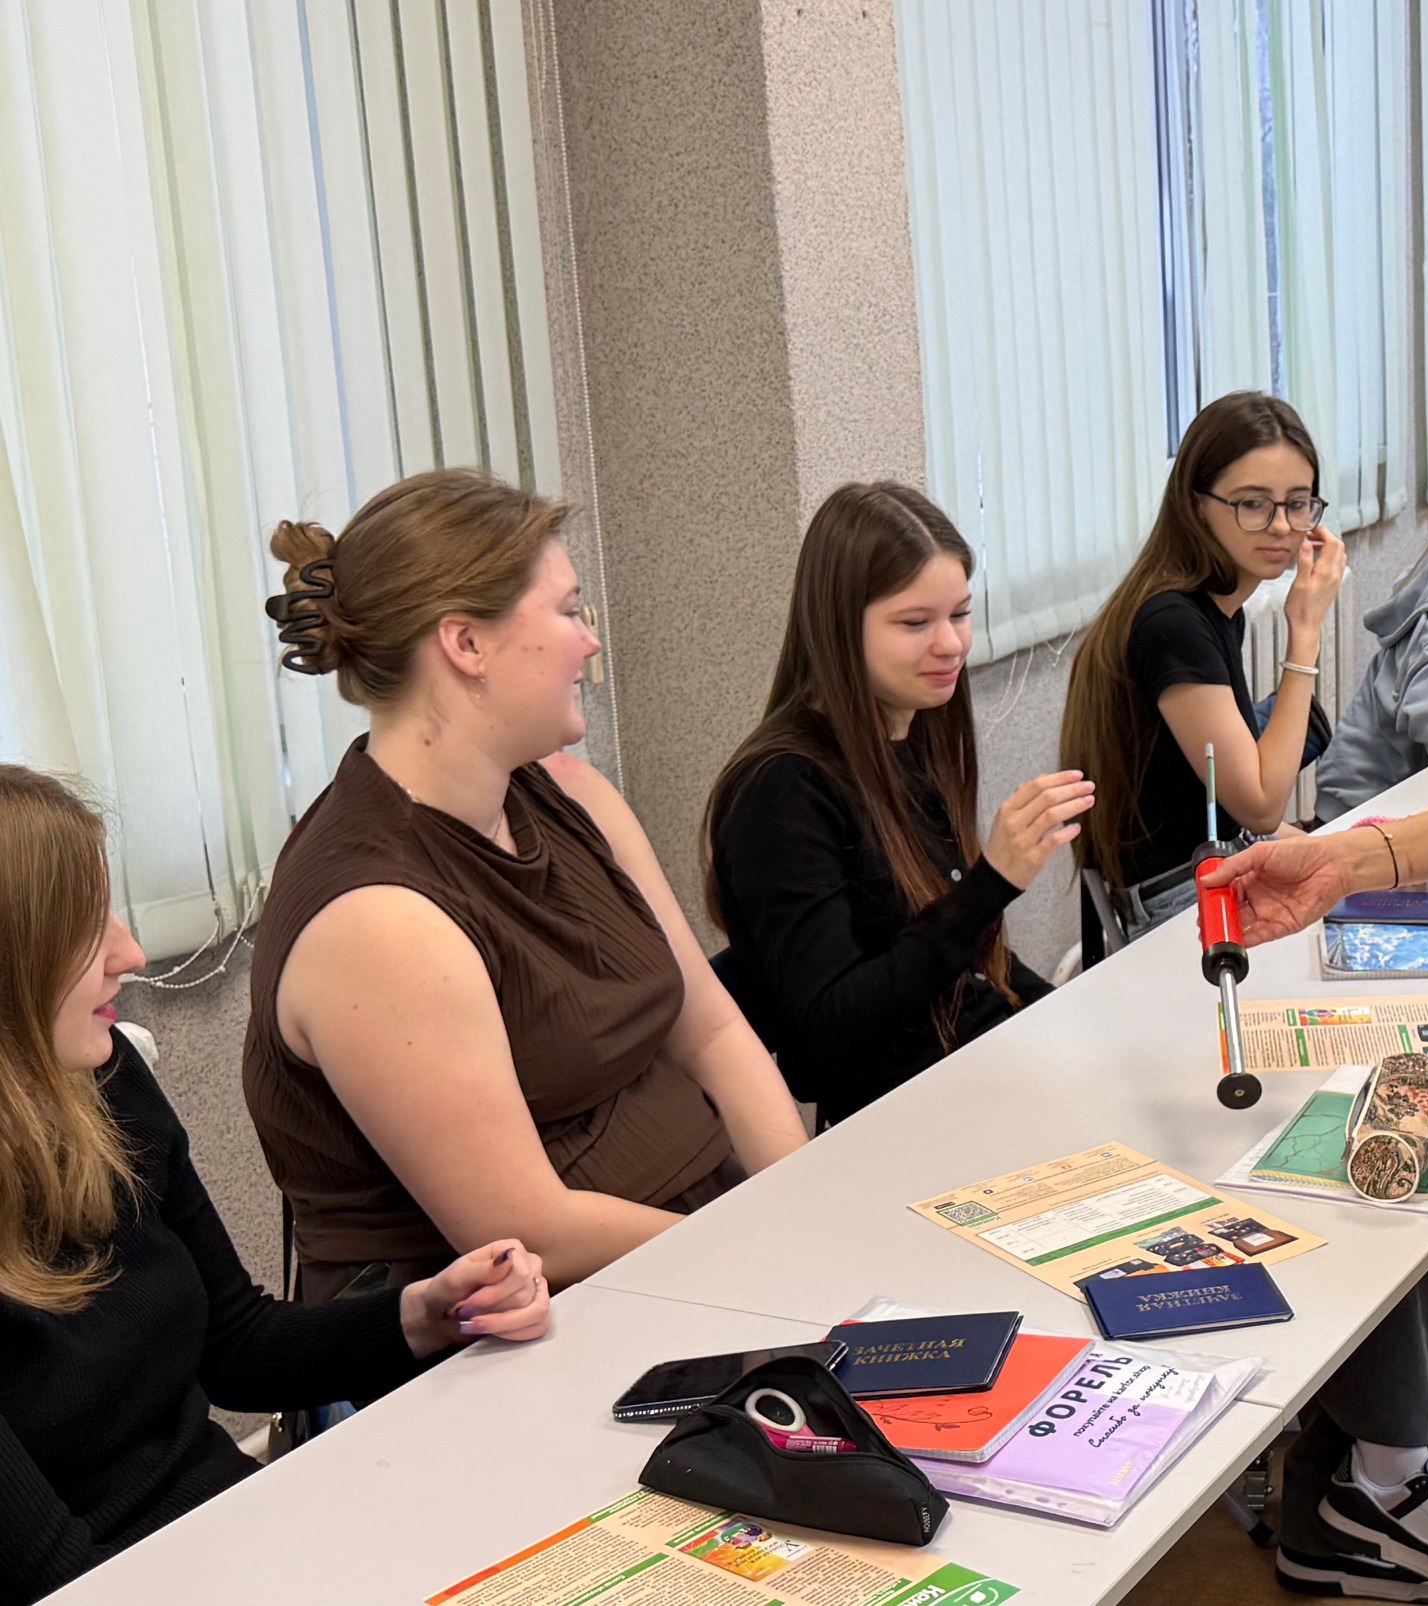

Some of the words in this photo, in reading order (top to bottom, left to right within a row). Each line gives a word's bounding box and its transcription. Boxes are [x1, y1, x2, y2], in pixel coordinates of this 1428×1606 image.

[1138, 1285, 1231, 1302] КНИЖКА
[853, 1350, 951, 1366] КНИЖКА
[1028, 1356, 1133, 1437] ФОРЕЛЬ
[1073, 1402, 1110, 1437] покупайте
[1107, 1394, 1119, 1404] на
[1088, 1415, 1127, 1448] Спасибо
[1127, 1403, 1140, 1417] за
[1140, 1364, 1179, 1401] покупку!
